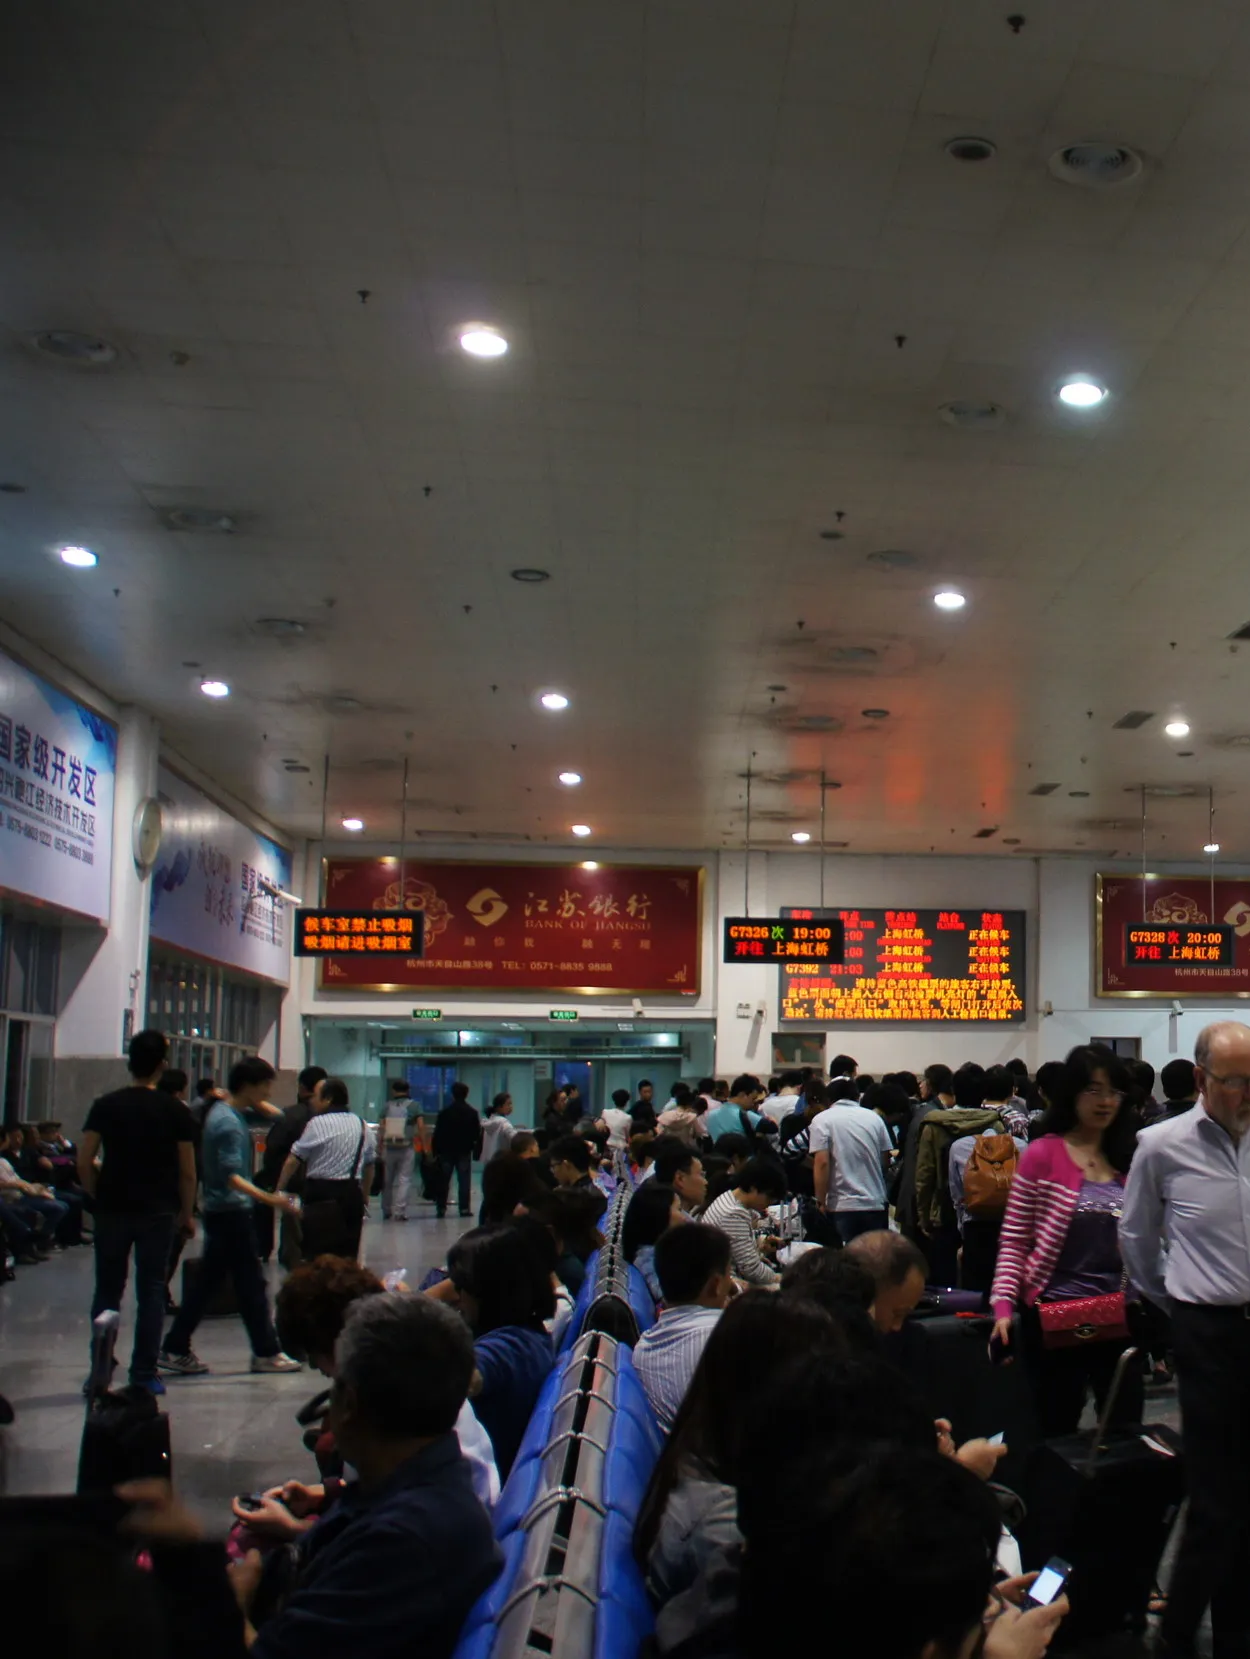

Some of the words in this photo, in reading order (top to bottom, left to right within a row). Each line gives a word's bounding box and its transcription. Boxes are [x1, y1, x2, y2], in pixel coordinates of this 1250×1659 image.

[0, 713, 97, 807] 国家级开发区
[304, 917, 413, 933] 候车室禁止吸烟
[525, 919, 563, 929] BANK
[570, 920, 587, 929] OF
[792, 927, 831, 940] 19:00
[882, 928, 924, 939] 上海虹桥
[968, 929, 1010, 941] 正在候车
[1187, 932, 1222, 944] 20:00
[304, 935, 412, 951] 吸烟请进吸烟室
[734, 941, 764, 956] 开往
[772, 942, 829, 956] 上海虹桥
[882, 945, 924, 956] 上海虹桥
[968, 946, 1010, 958] 正在候车
[1135, 946, 1161, 959] 开往
[1168, 946, 1220, 960] 上海虹桥
[785, 964, 819, 974] G7392
[829, 964, 864, 975] 21:03
[882, 961, 924, 972] 上海虹桥
[968, 962, 1010, 974] 正在候车
